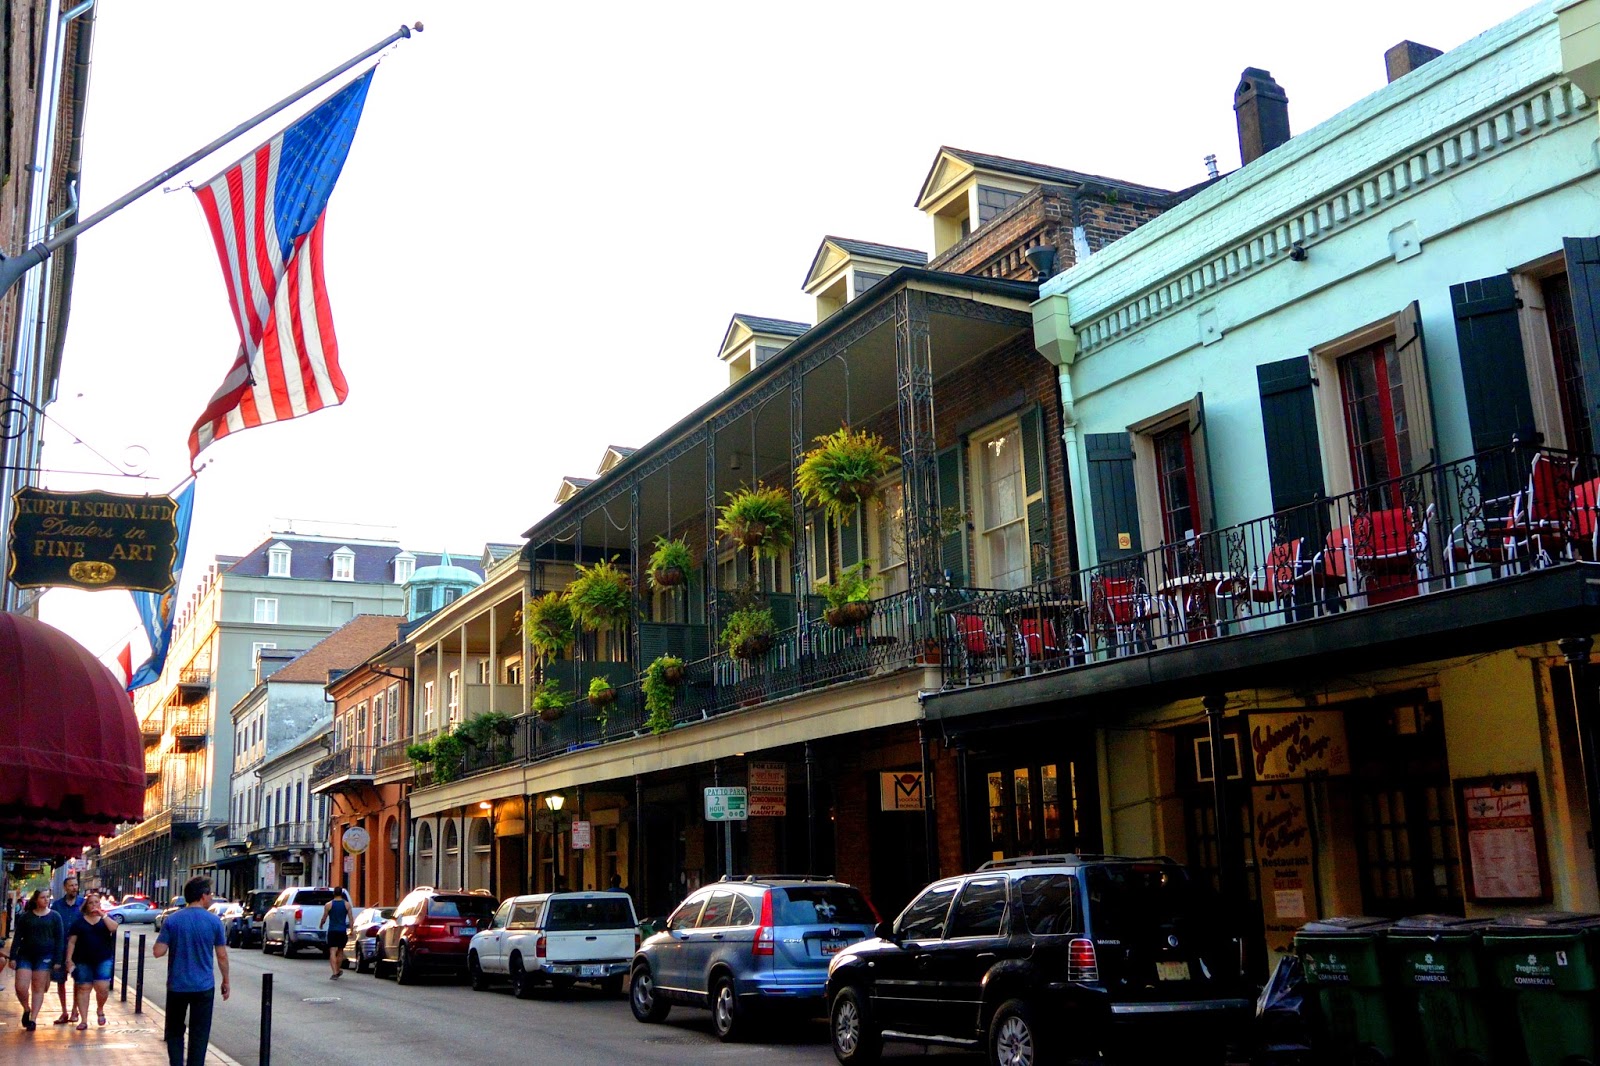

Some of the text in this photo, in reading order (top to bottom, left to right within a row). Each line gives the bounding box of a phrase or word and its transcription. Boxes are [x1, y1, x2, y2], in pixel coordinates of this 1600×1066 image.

[21, 499, 67, 515] KURT
[37, 517, 147, 540] Dealers in
[33, 540, 157, 561] FINE ART
[1252, 714, 1314, 775] Johnny's
[714, 796, 720, 805] 2
[1257, 802, 1302, 848] Johnny's
[1262, 856, 1309, 867] Restaurant
[1514, 976, 1556, 985] COMMERCIAL
